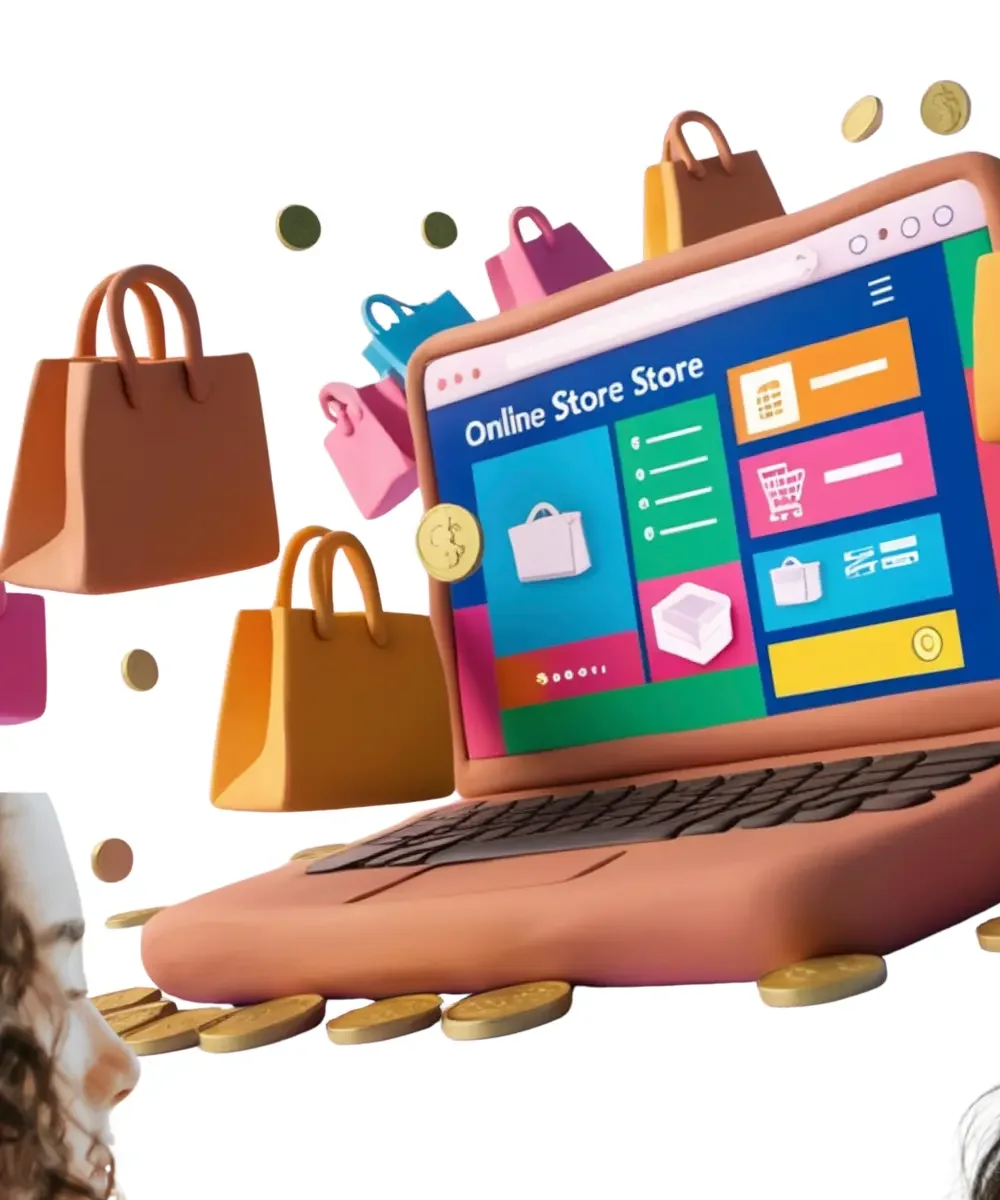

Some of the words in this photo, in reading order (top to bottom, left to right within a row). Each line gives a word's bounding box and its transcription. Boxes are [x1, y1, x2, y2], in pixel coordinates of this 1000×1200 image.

[464, 406, 546, 447] Online
[550, 381, 625, 422] Store
[630, 355, 704, 397] Store
